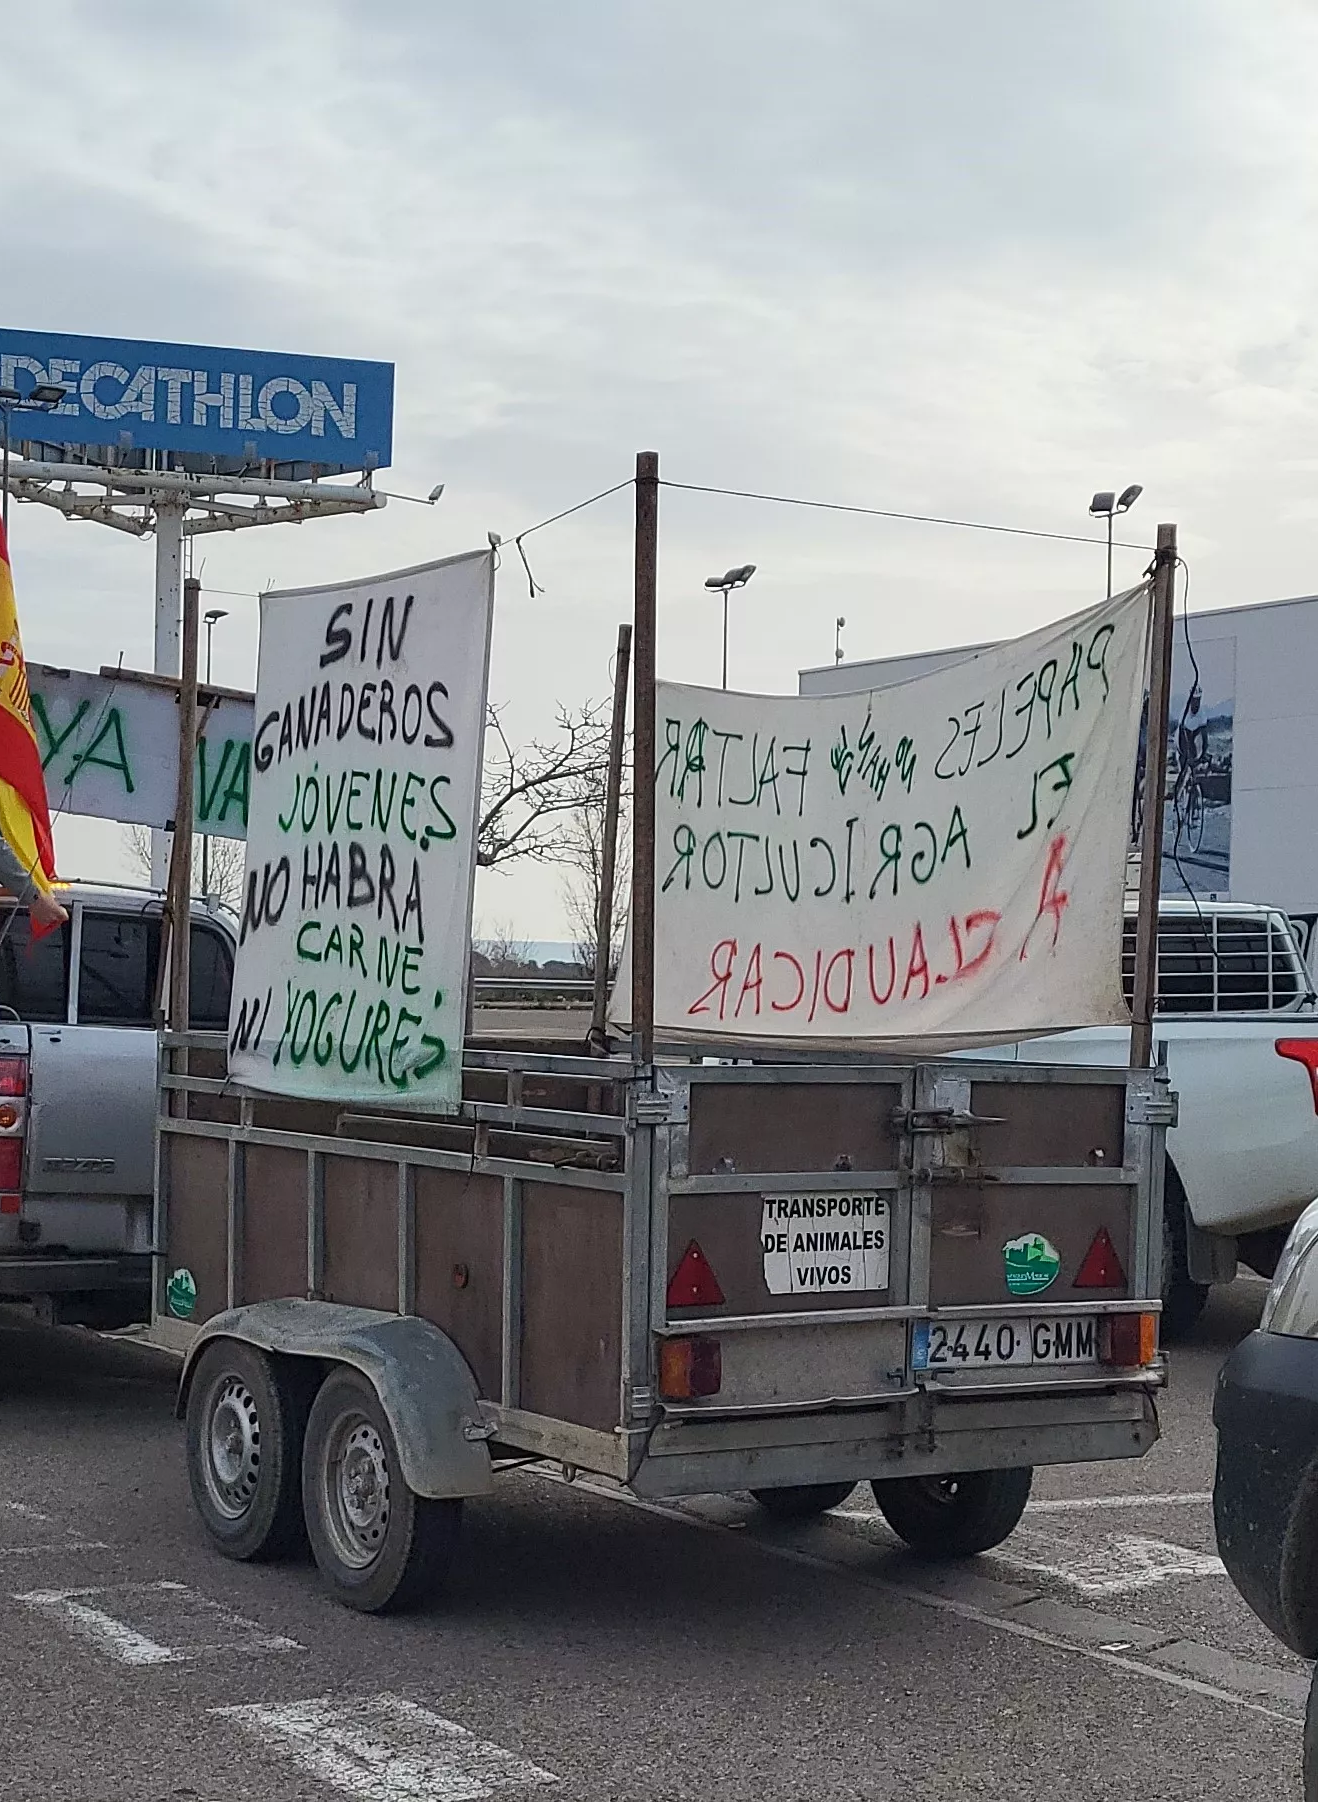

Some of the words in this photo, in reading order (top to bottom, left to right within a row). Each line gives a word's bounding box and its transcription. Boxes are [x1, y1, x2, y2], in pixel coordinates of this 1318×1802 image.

[0, 353, 356, 439] DECATHLON
[319, 595, 414, 669] SIN
[30, 693, 134, 792] YA
[254, 679, 455, 773] GANADEROS
[278, 760, 457, 841] JÓVENES
[238, 855, 291, 947] NO
[296, 920, 424, 995] CARNE
[231, 986, 272, 1051] NI
[764, 1233, 788, 1254] DE
[793, 1229, 885, 1253] ANIMALES
[765, 1196, 885, 1219] TRANSPORTE
[796, 1265, 852, 1287] VIVOS
[929, 1323, 1015, 1363] 2440
[1033, 1321, 1094, 1360] GMM
